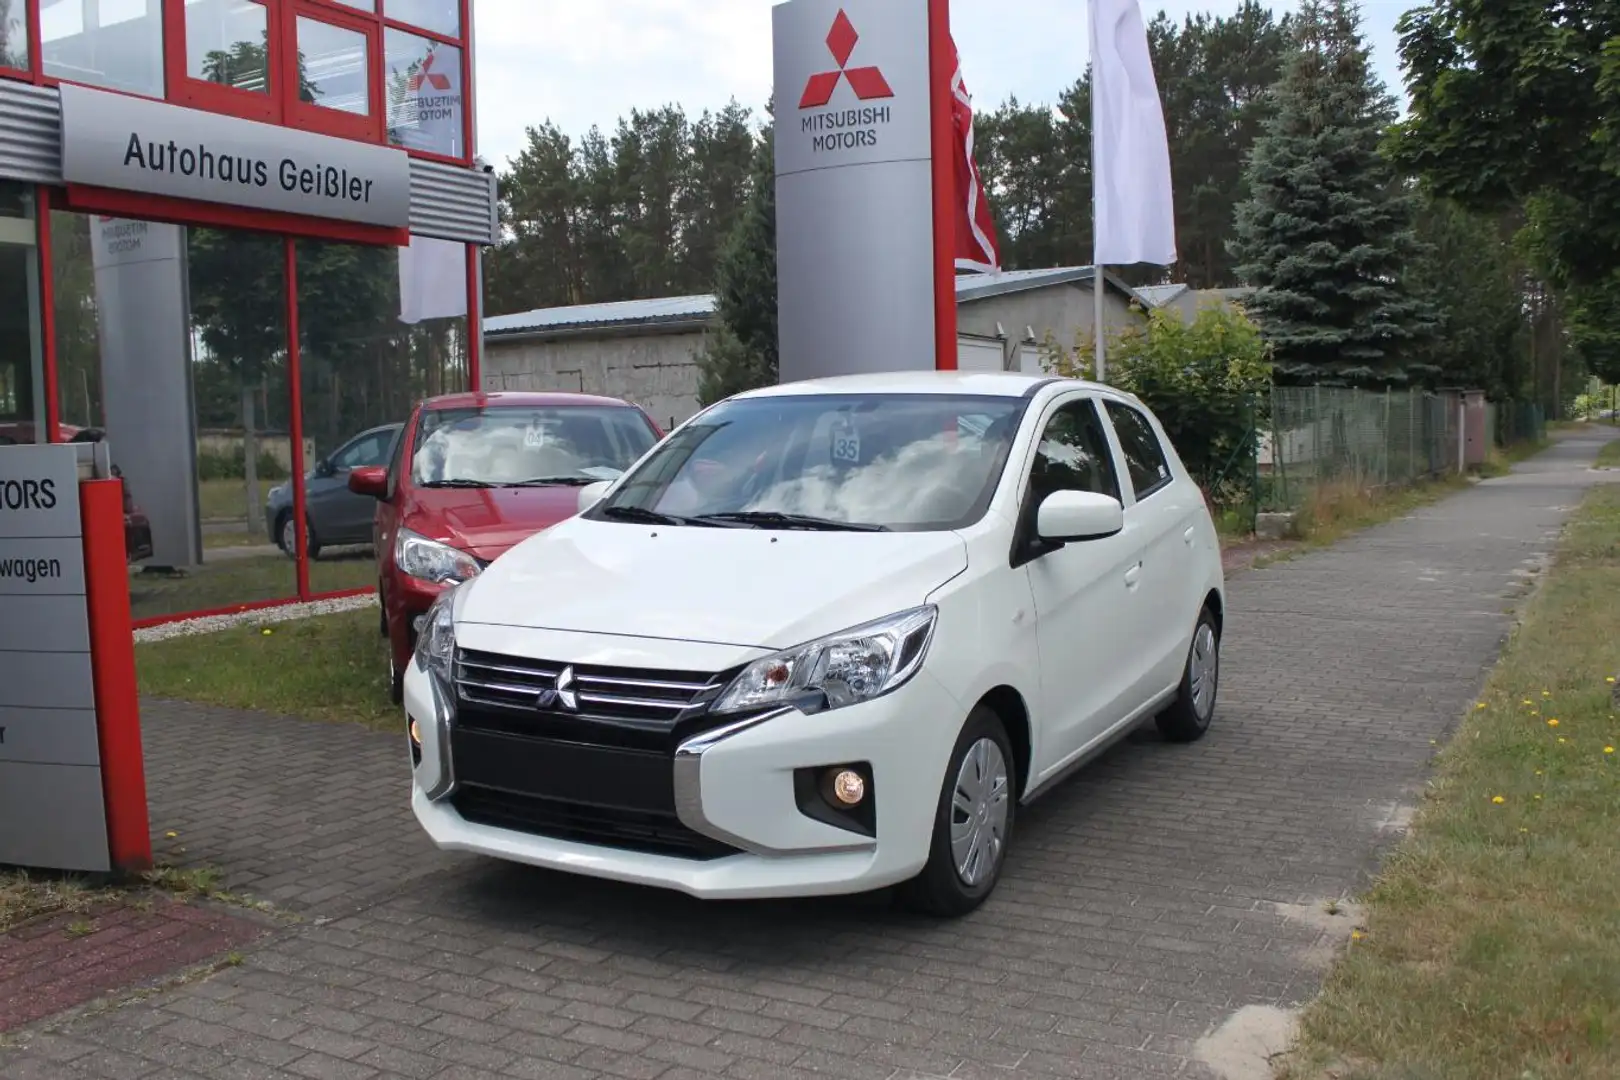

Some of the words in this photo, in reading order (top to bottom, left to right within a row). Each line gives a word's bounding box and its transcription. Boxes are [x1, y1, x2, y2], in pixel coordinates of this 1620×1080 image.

[801, 106, 890, 132] MITSUBISHI
[813, 129, 877, 152] MOTORS
[124, 132, 267, 187] Autohaus
[279, 158, 373, 202] Geißler
[836, 438, 858, 459] 35
